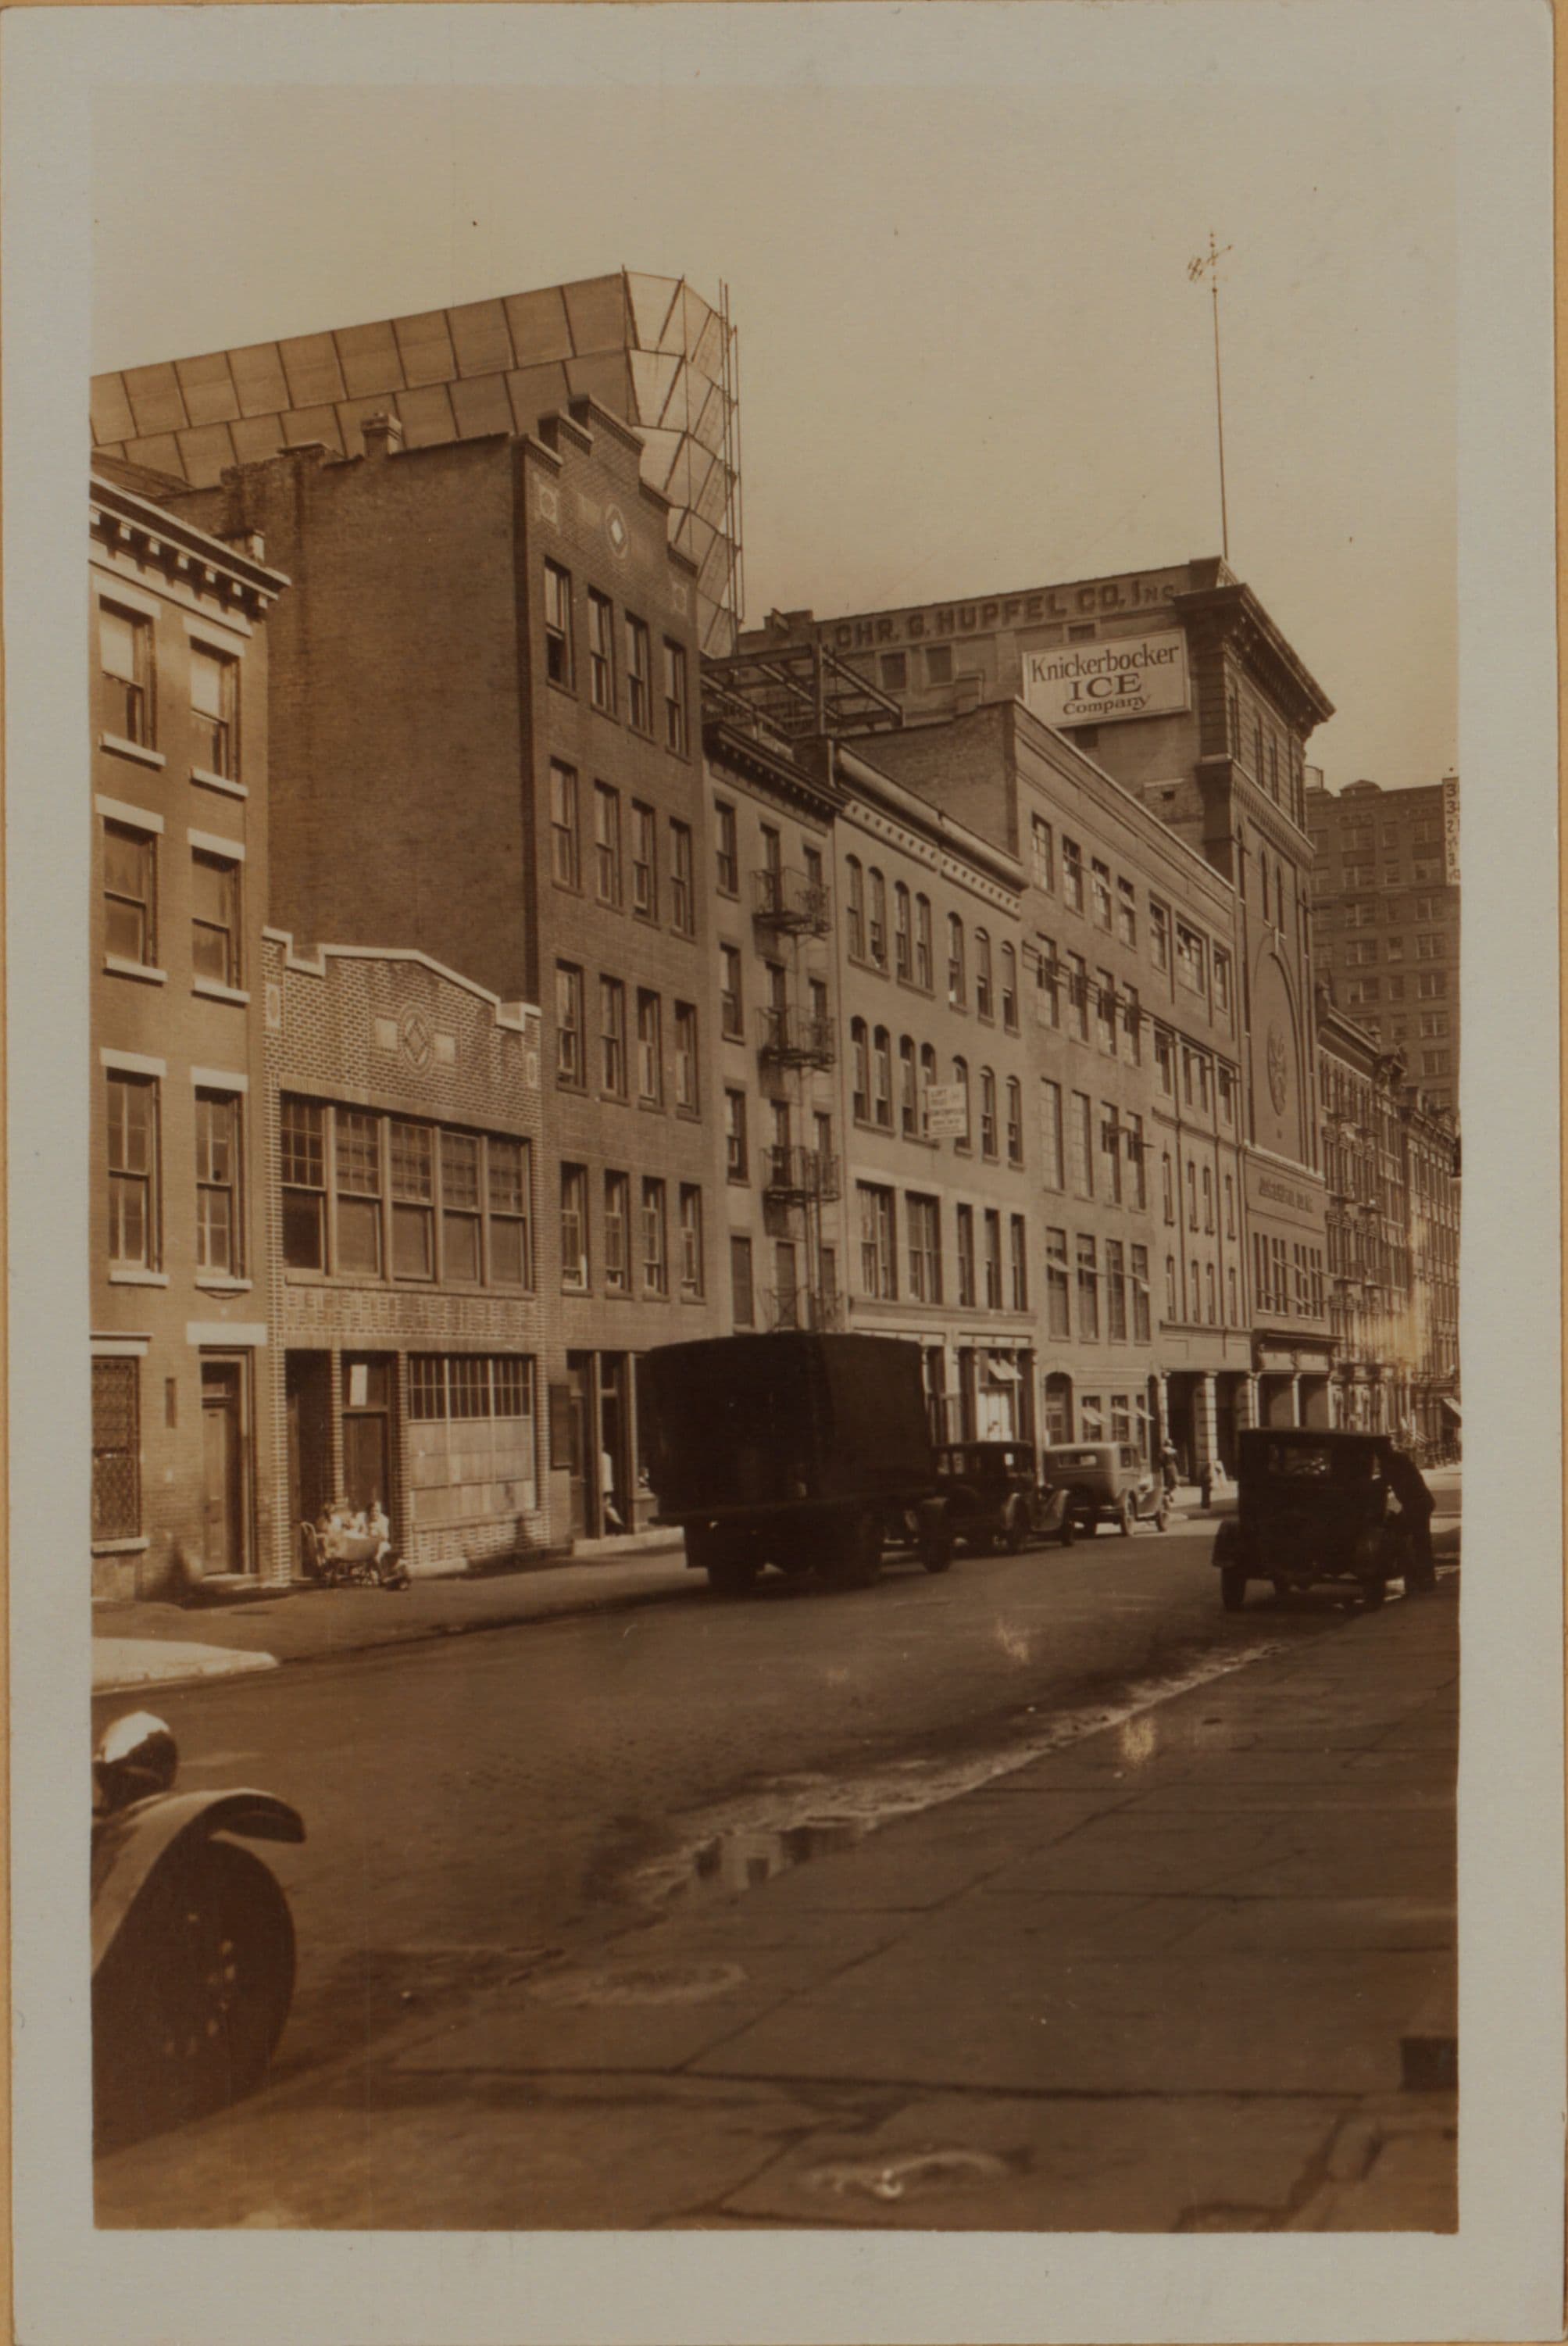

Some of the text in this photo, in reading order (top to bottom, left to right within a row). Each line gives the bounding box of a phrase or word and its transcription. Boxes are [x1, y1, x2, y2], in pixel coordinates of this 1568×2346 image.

[837, 617, 899, 647] CHR.
[907, 614, 930, 640] G.
[937, 593, 1067, 636] HUPFEL
[1077, 583, 1126, 614] CO.
[1031, 642, 1180, 683] Knickerbocker
[1063, 694, 1152, 715] Company
[1070, 673, 1141, 702] ICE
